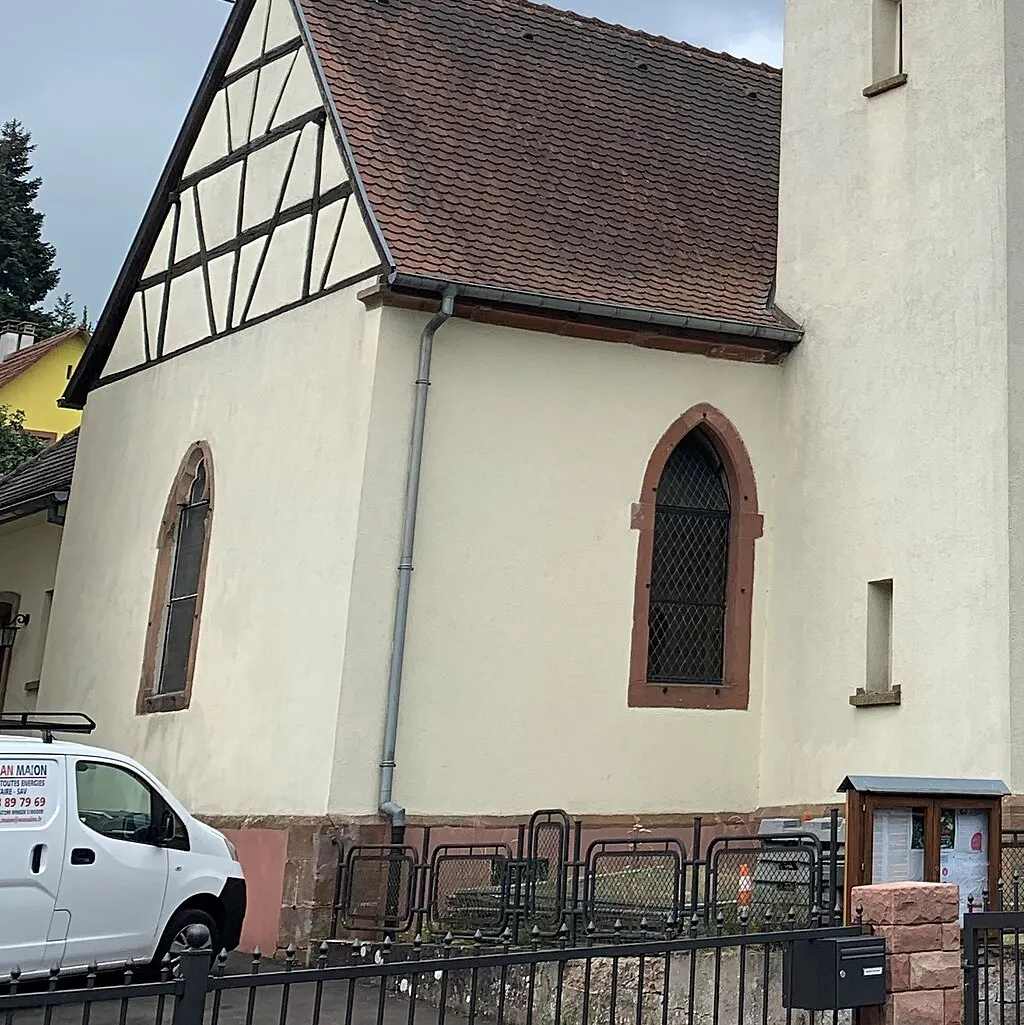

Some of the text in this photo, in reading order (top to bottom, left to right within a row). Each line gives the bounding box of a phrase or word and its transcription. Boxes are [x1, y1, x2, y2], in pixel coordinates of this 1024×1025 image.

[16, 765, 47, 776] MAION
[4, 796, 46, 807] 89 79 69
